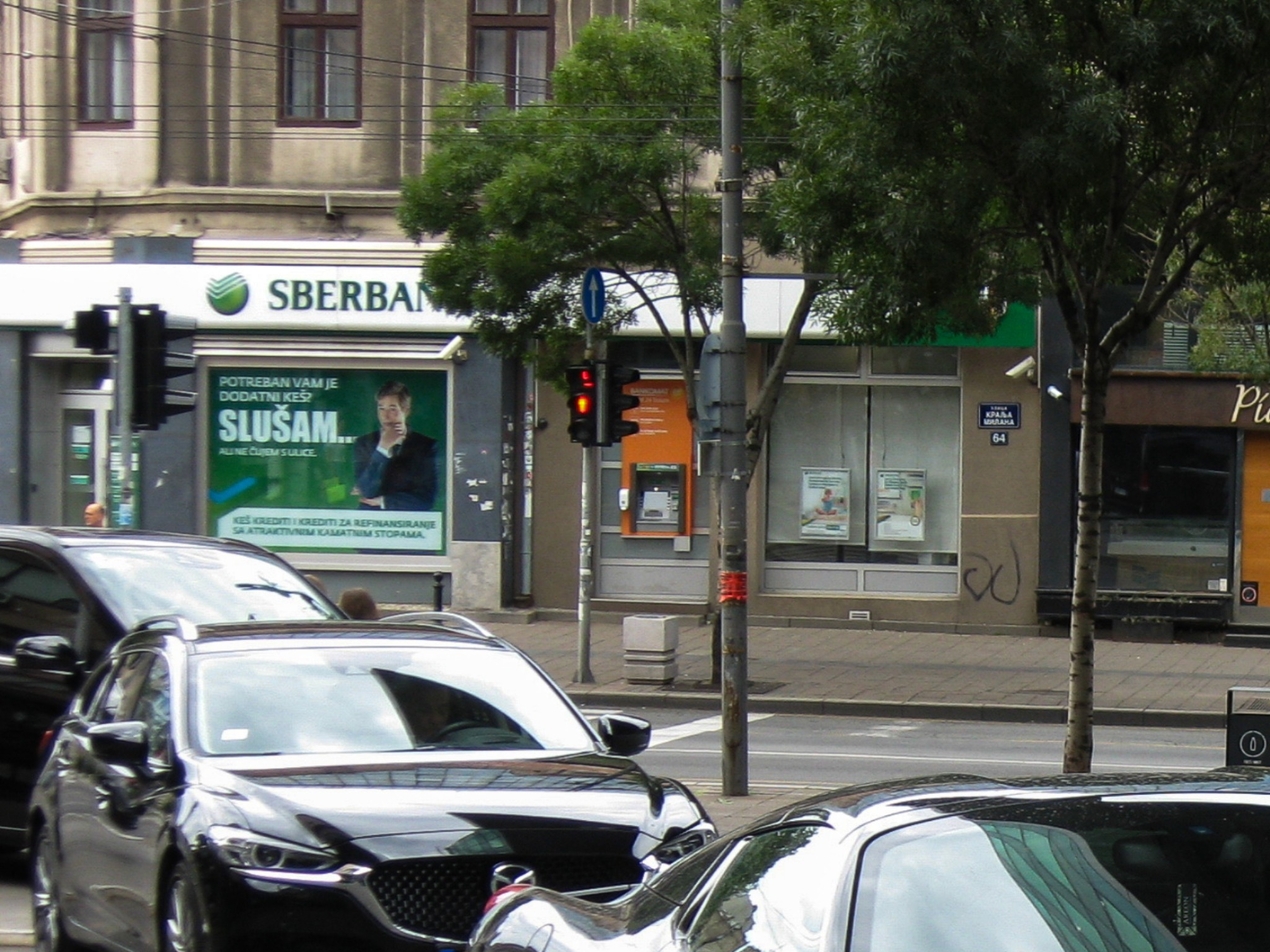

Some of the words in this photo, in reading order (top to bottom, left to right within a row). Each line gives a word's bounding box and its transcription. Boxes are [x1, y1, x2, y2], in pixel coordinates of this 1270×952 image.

[268, 279, 437, 312] SBERBAN
[219, 376, 290, 388] POTREBAN
[291, 377, 323, 388] VAM
[324, 378, 339, 390] JE
[219, 391, 281, 402] DODATNI
[282, 389, 312, 403] KEŠ?
[218, 404, 358, 443] SLUŠAM...
[992, 432, 1006, 443] 64
[235, 447, 249, 456] NE
[233, 515, 250, 525] KEŠ
[252, 517, 292, 526] KREDITI
[300, 517, 338, 527] KREDITI
[338, 518, 352, 527] ZA
[354, 519, 437, 530] REFINANSIRANJE
[232, 526, 246, 535] SA
[247, 527, 316, 537] ATRAKTIVNIM
[317, 528, 373, 538] KAMATNIM
